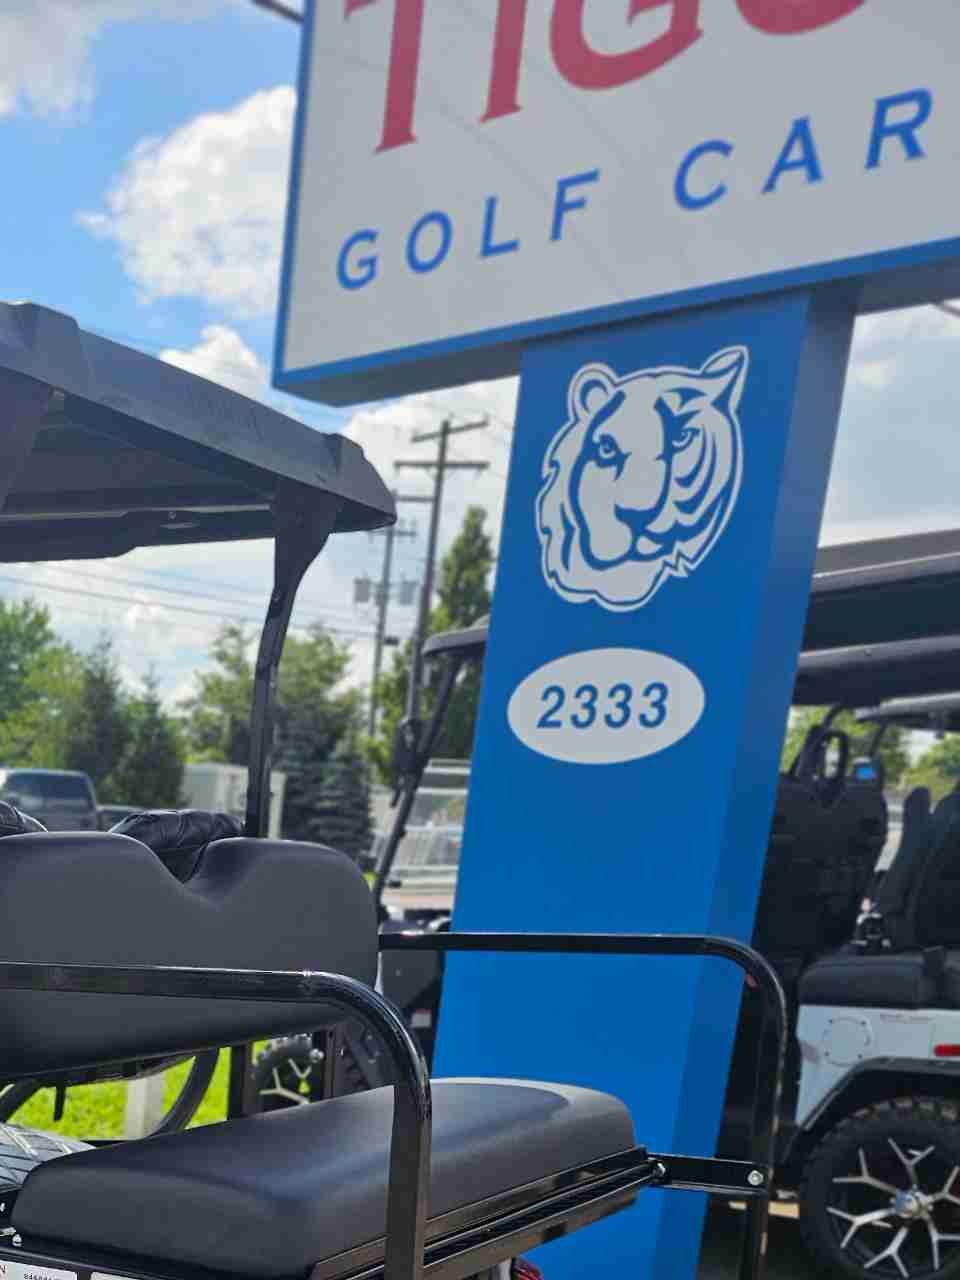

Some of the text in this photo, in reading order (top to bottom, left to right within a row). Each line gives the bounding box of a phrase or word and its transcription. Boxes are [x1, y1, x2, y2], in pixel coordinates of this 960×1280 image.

[336, 87, 933, 290] GOLF CAR
[536, 682, 669, 729] 2333
